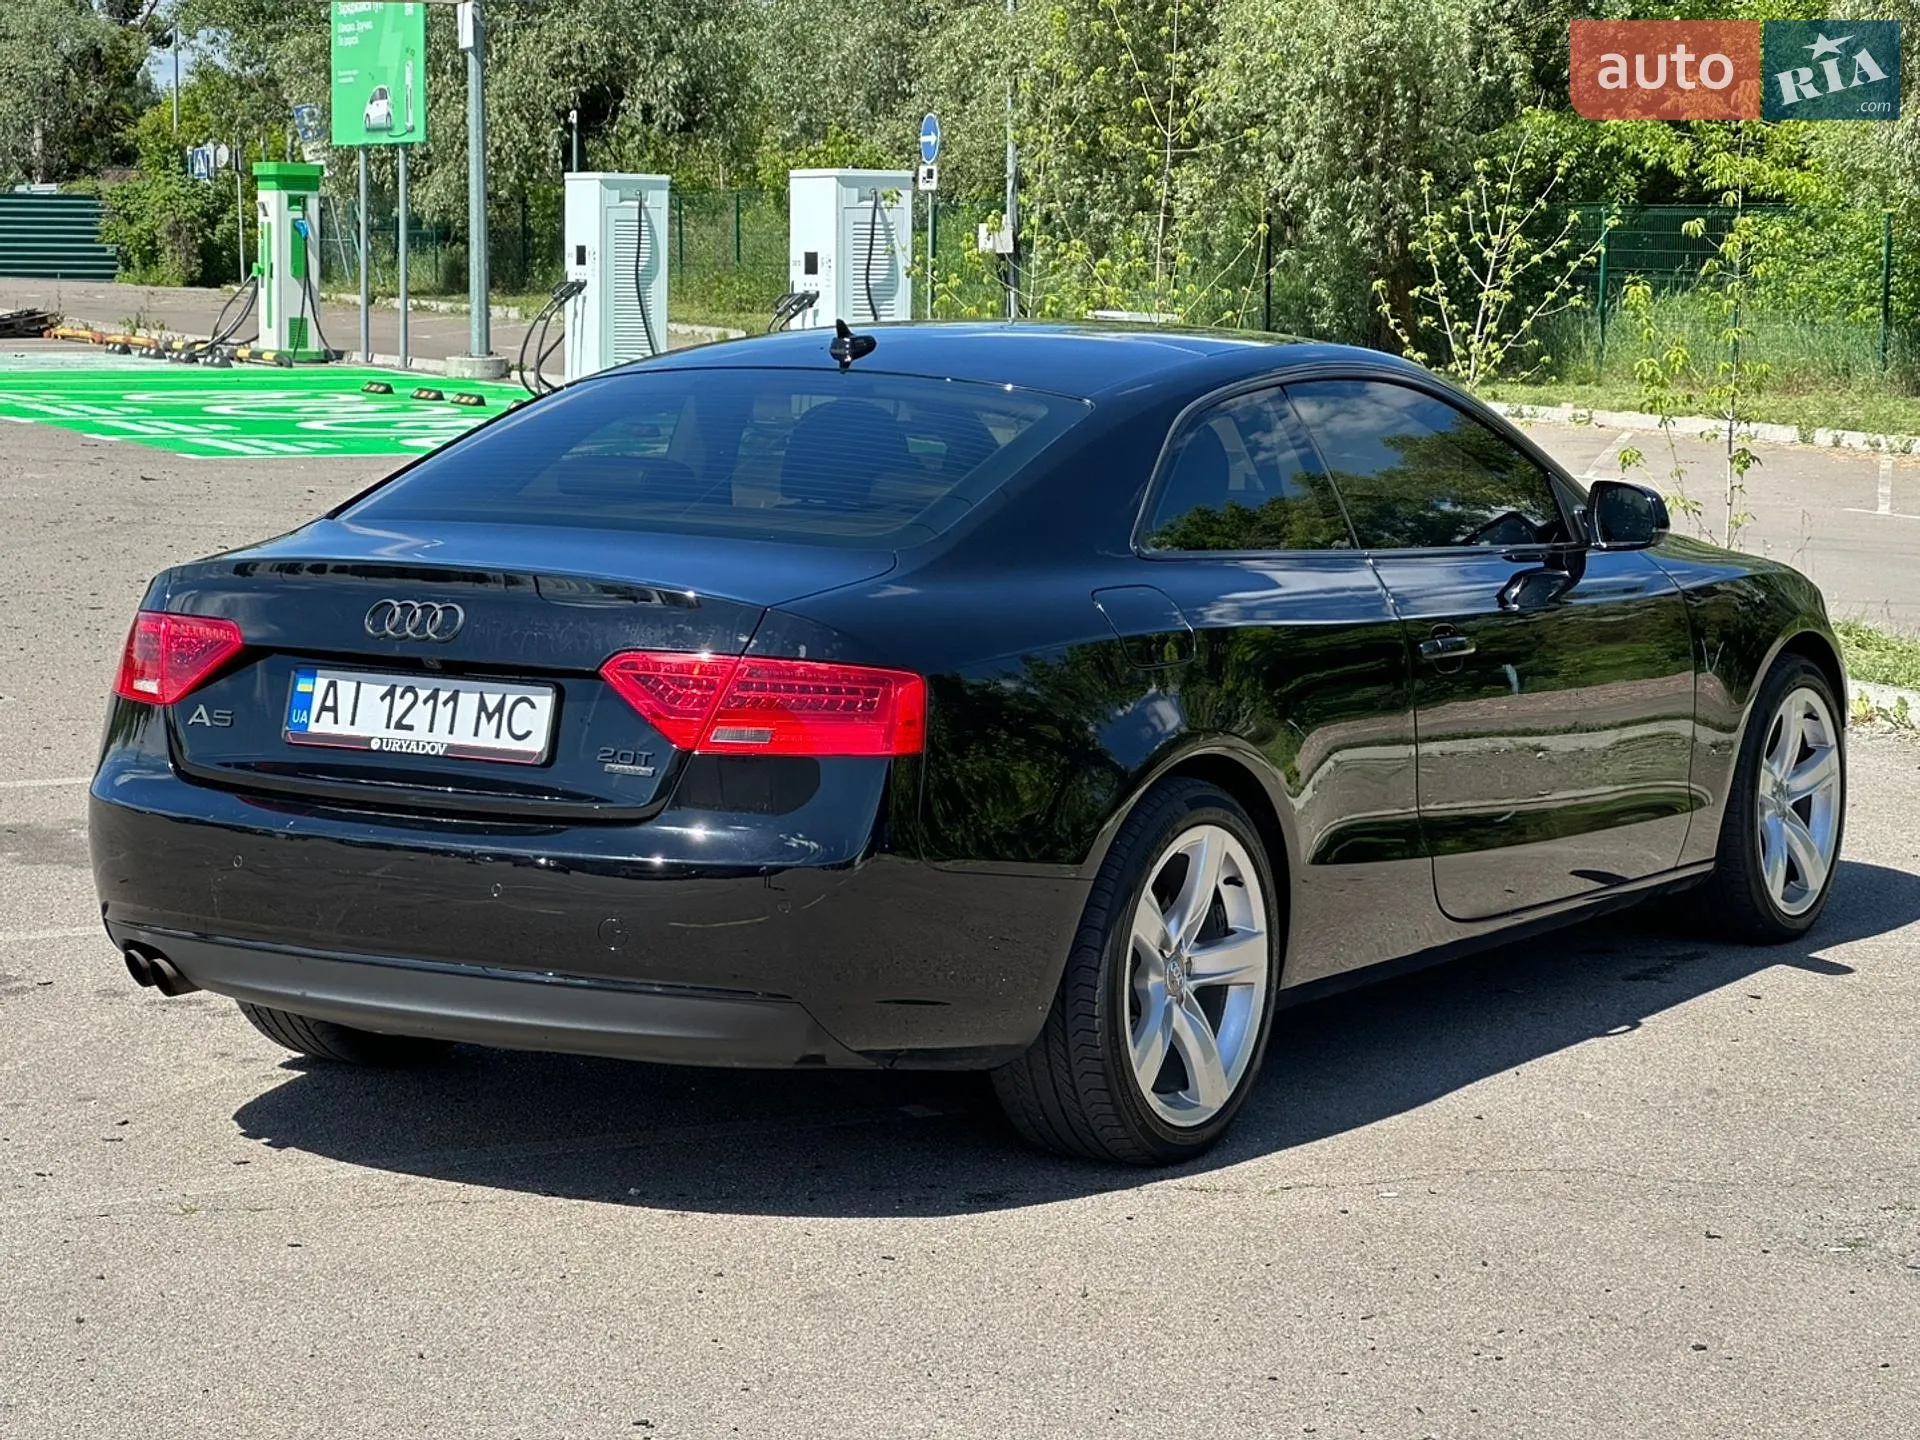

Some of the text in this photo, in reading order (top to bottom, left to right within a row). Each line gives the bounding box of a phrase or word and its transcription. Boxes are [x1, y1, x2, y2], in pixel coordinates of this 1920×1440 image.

[187, 703, 234, 727] A5
[292, 708, 308, 725] UA
[314, 680, 537, 741] AI 1211 MC
[382, 738, 448, 755] URYADOV
[597, 746, 655, 766] 2.0T
